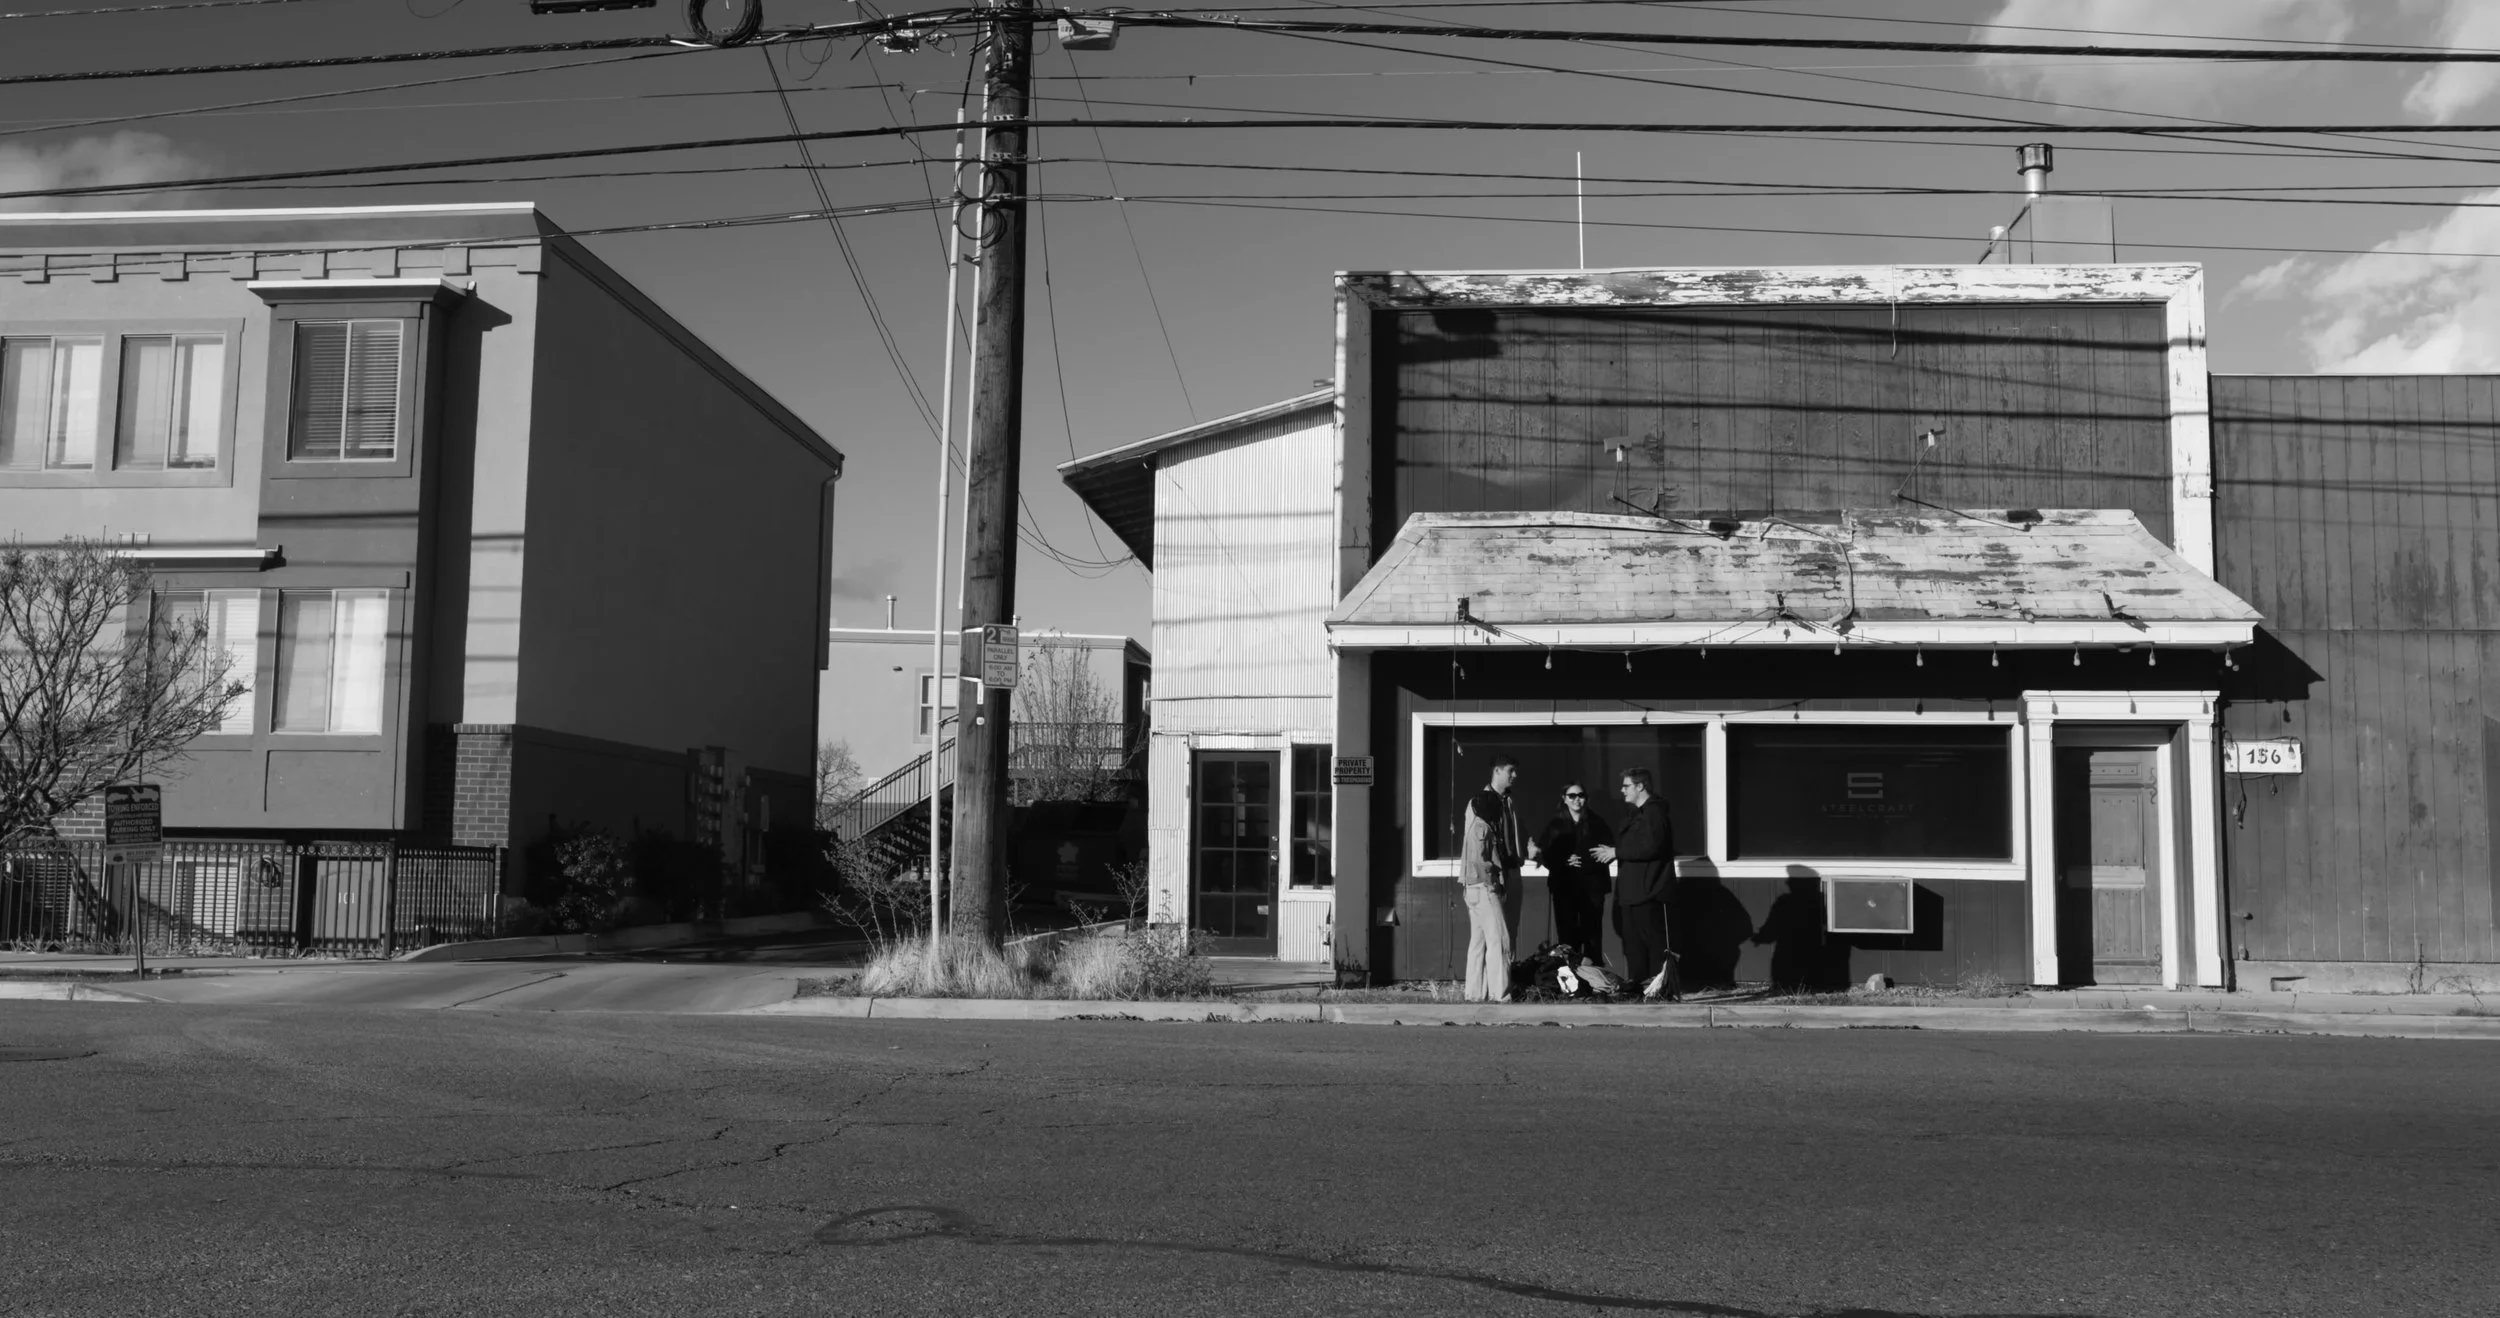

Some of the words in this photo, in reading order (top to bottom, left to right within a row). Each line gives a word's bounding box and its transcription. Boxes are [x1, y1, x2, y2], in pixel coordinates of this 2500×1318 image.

[986, 627, 997, 643] 2
[987, 647, 1014, 655] PARALLEL
[2246, 748, 2281, 765] 156
[1338, 759, 1366, 767] PRIVATE
[1334, 767, 1370, 775] PROPERTY
[107, 804, 130, 813] TOWING
[131, 803, 159, 812] ENFORCED
[1821, 803, 1915, 813] STEELCRAFT
[113, 818, 153, 826] AUTHORIZED
